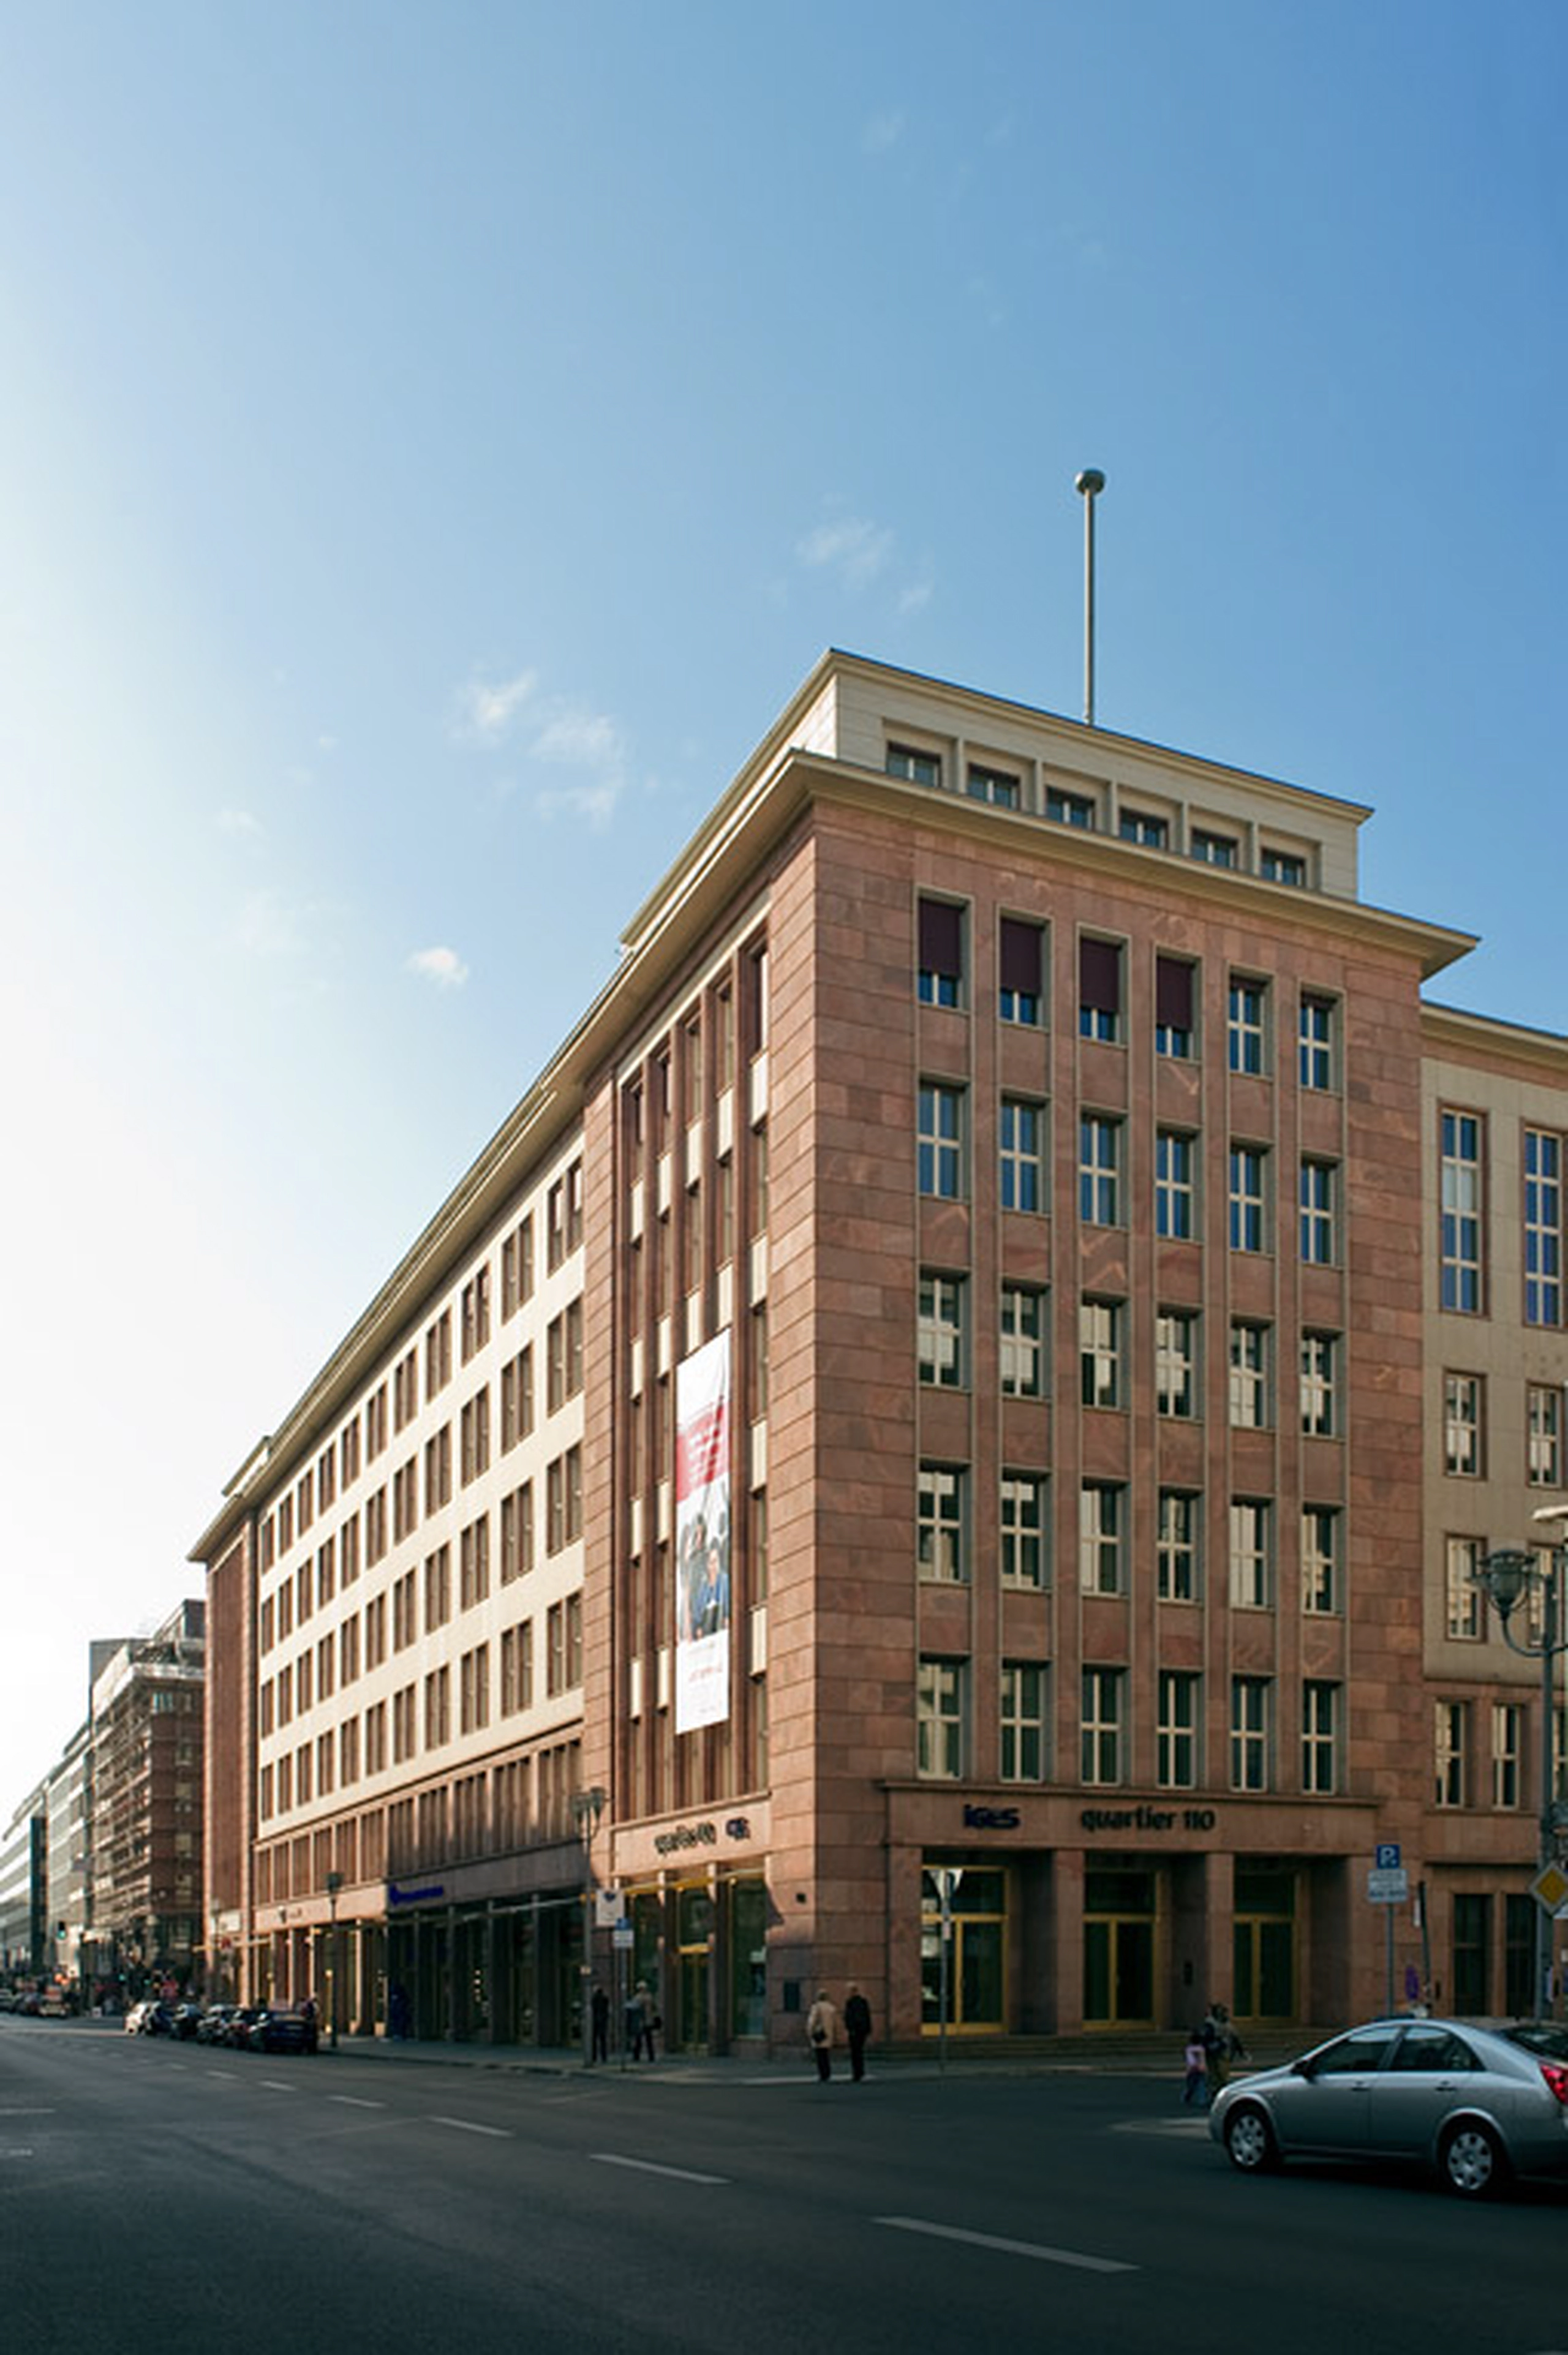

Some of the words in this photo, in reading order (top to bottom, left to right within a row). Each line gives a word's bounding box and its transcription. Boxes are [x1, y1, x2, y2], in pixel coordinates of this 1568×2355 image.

[1082, 1806, 1177, 1832] quartier
[1182, 1809, 1216, 1831] 110
[1380, 1847, 1396, 1866] P
